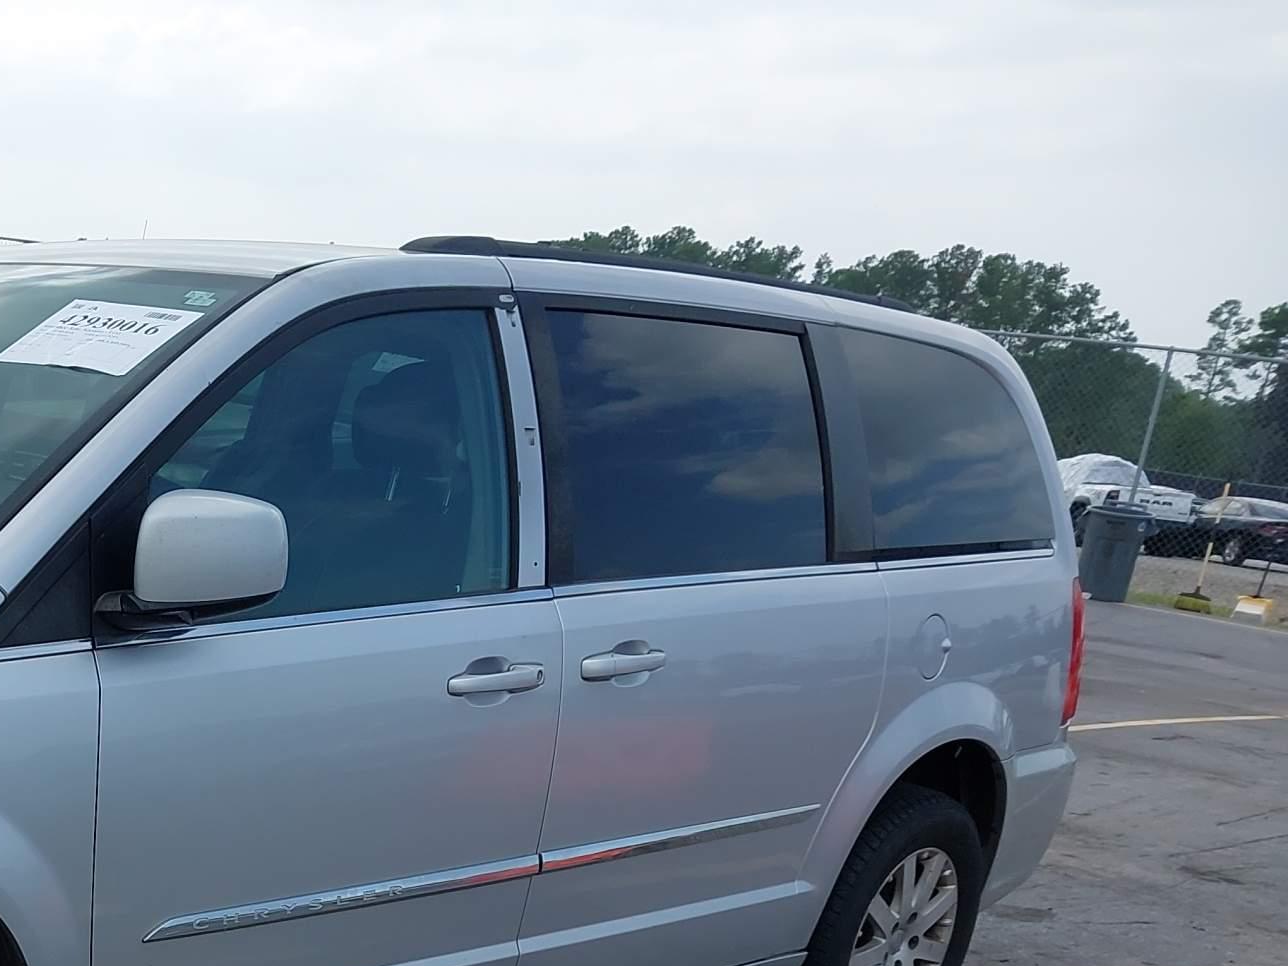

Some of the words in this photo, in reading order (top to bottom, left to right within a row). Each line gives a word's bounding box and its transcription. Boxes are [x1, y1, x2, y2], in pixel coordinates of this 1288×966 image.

[59, 314, 166, 336] 42930016
[1139, 498, 1173, 507] RAM
[192, 884, 404, 930] CHRYSLER
